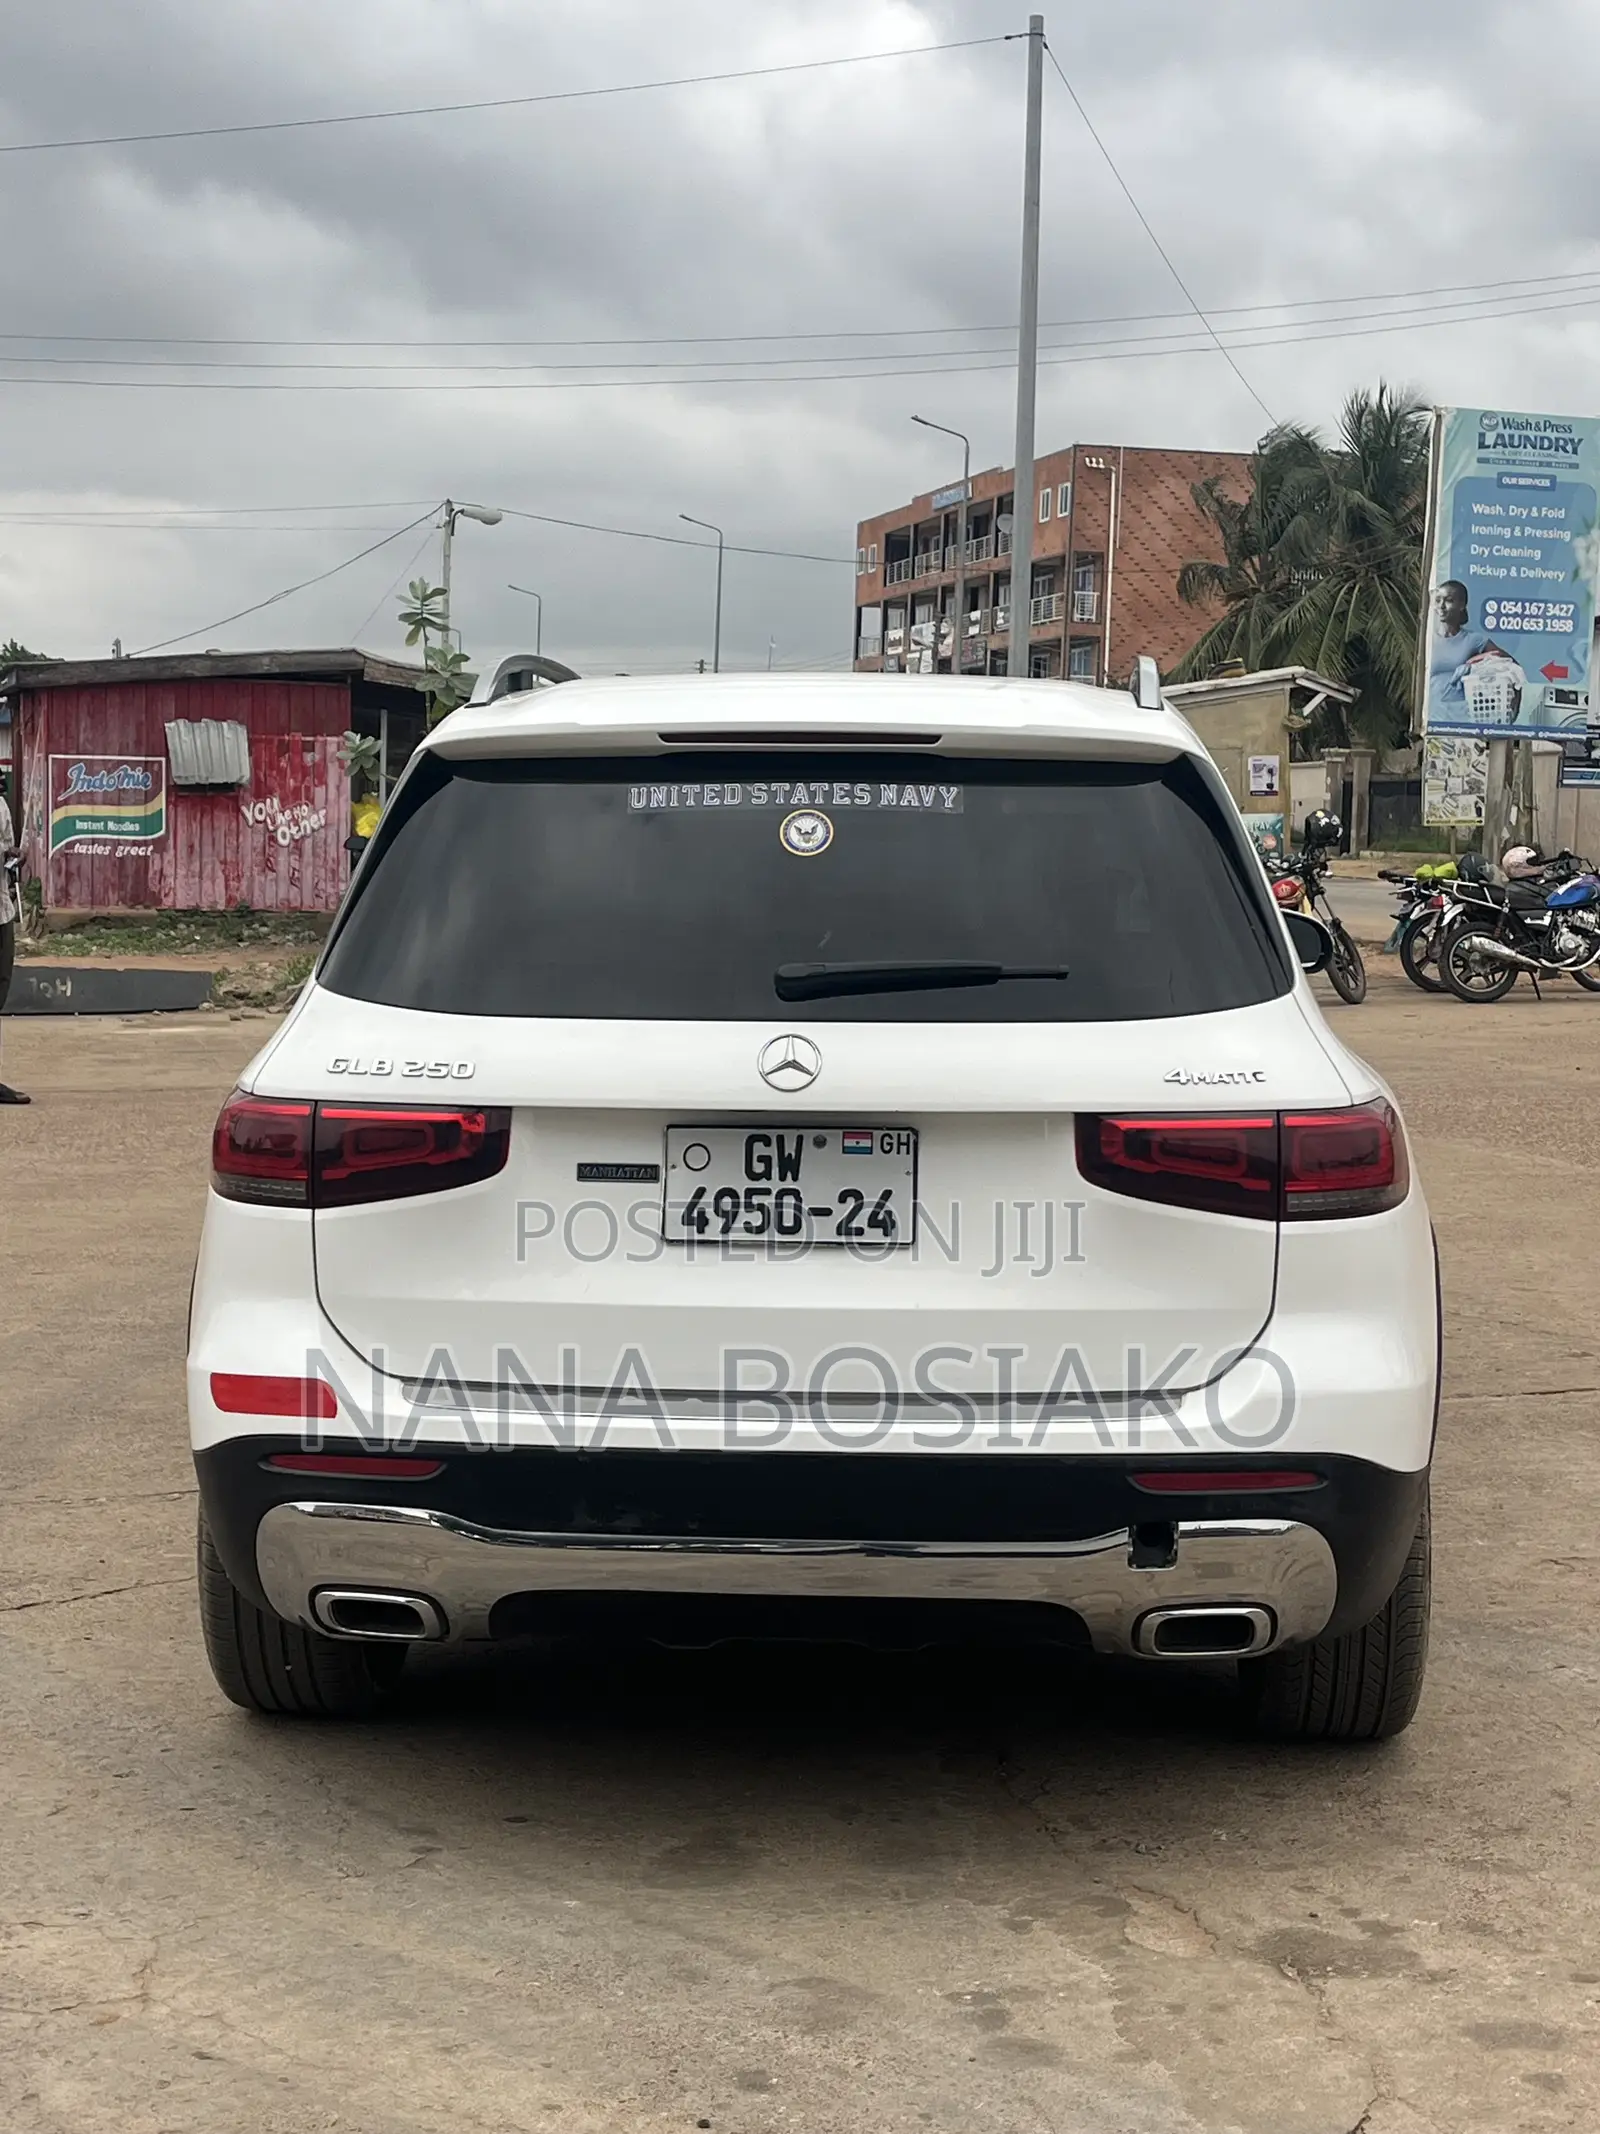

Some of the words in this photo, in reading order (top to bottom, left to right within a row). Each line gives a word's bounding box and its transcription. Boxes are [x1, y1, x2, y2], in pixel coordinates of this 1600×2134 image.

[1478, 432, 1584, 456] LAUNDRY
[1502, 476, 1517, 485] OUR
[1518, 477, 1551, 487] SERVICES
[1508, 505, 1529, 519] Dry
[1530, 506, 1539, 517] &
[1541, 507, 1566, 519] Fold
[1471, 524, 1511, 539] Ironing
[1513, 526, 1521, 537] &
[1524, 527, 1571, 542] Pressing
[1470, 544, 1490, 558] Dry
[1492, 545, 1542, 560] Cleaning
[1469, 564, 1508, 579] Pickup
[1509, 566, 1518, 577] &
[1520, 567, 1566, 582] Delivery
[1500, 601, 1522, 614] 054
[1524, 602, 1545, 616] 167
[1546, 603, 1575, 617] 3427
[1499, 616, 1521, 630] 020
[1522, 618, 1544, 631] 653
[1545, 619, 1574, 633] 1958
[630, 783, 743, 808] UNITED
[750, 782, 872, 806] STATES
[879, 784, 958, 809] NAVY
[75, 820, 104, 831] Instant
[107, 820, 140, 832] Noodles
[115, 844, 154, 858] great
[326, 1056, 394, 1076] GLB
[401, 1059, 475, 1080] 250
[1163, 1067, 1267, 1086] 4MATIC
[744, 1133, 804, 1183] GW
[880, 1132, 912, 1155] GH
[580, 1166, 656, 1178] MANHATTAN
[681, 1186, 897, 1237] 4950-24
